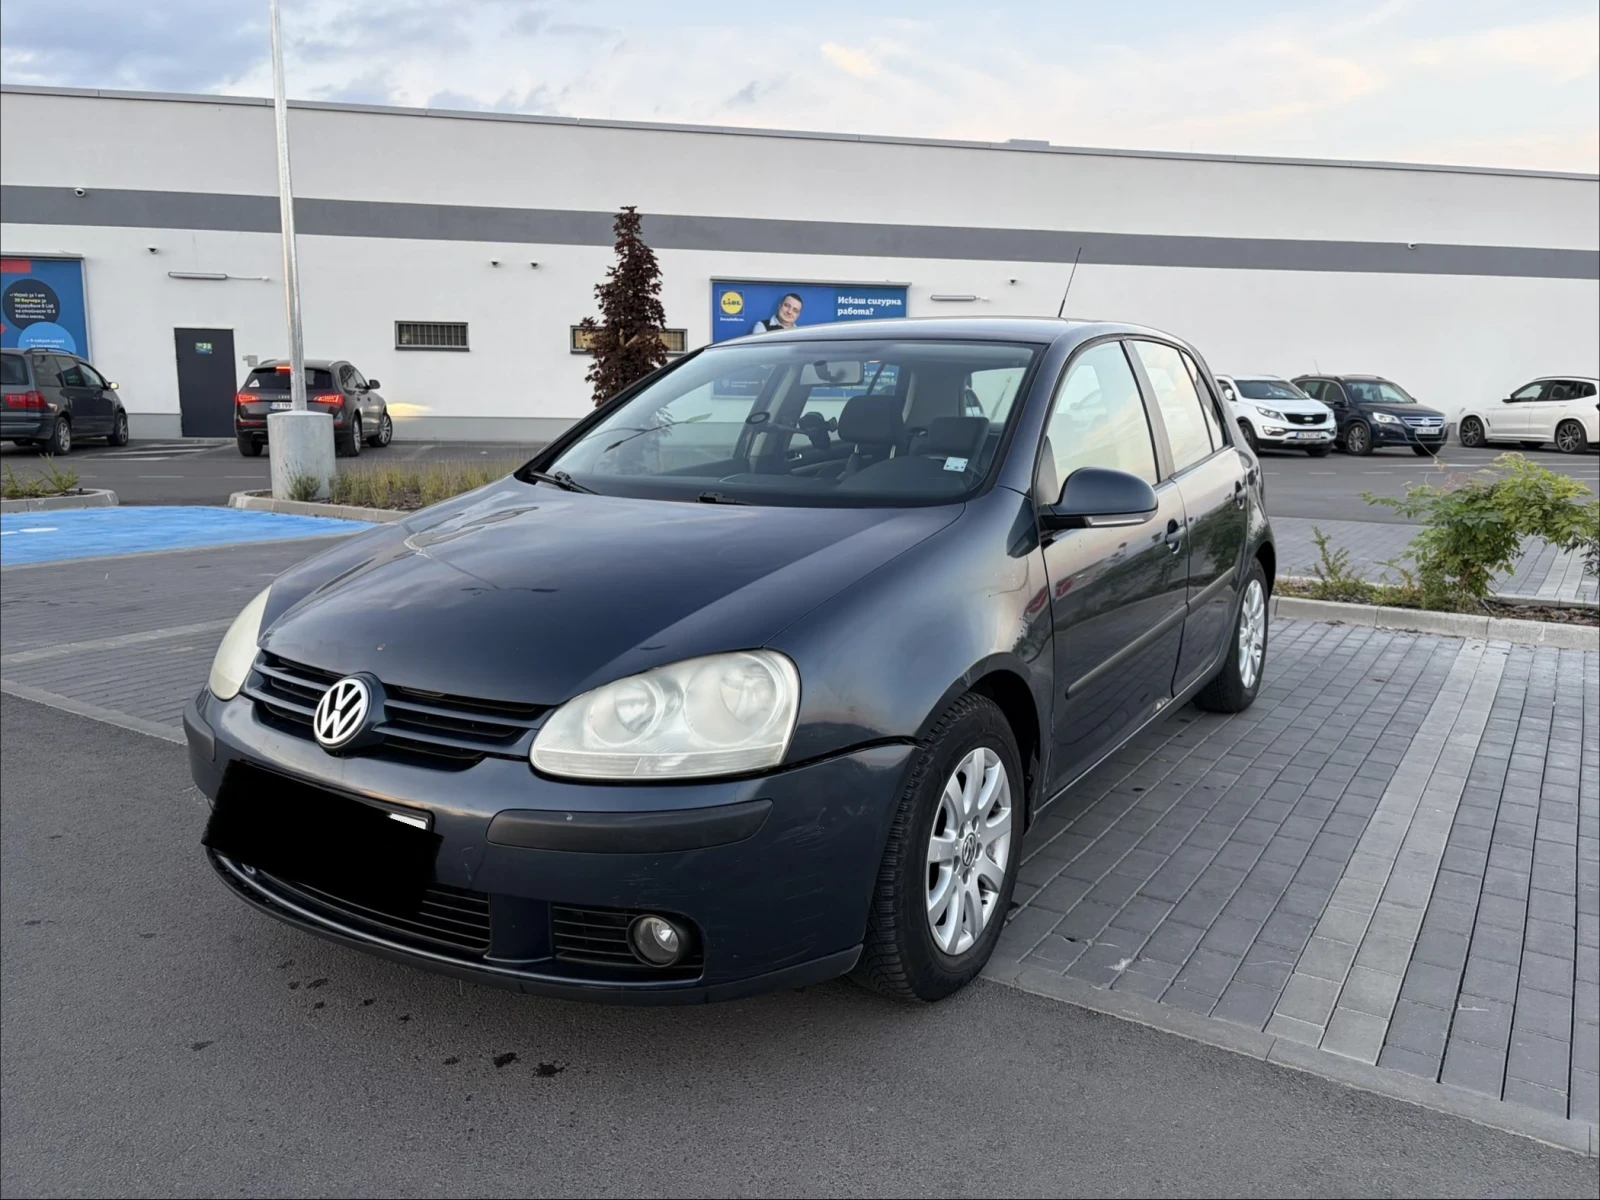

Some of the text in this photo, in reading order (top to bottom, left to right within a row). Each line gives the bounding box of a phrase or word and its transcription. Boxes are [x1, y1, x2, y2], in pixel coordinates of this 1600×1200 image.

[837, 296, 902, 306] Искаш сигурна
[837, 307, 875, 316] работа?
